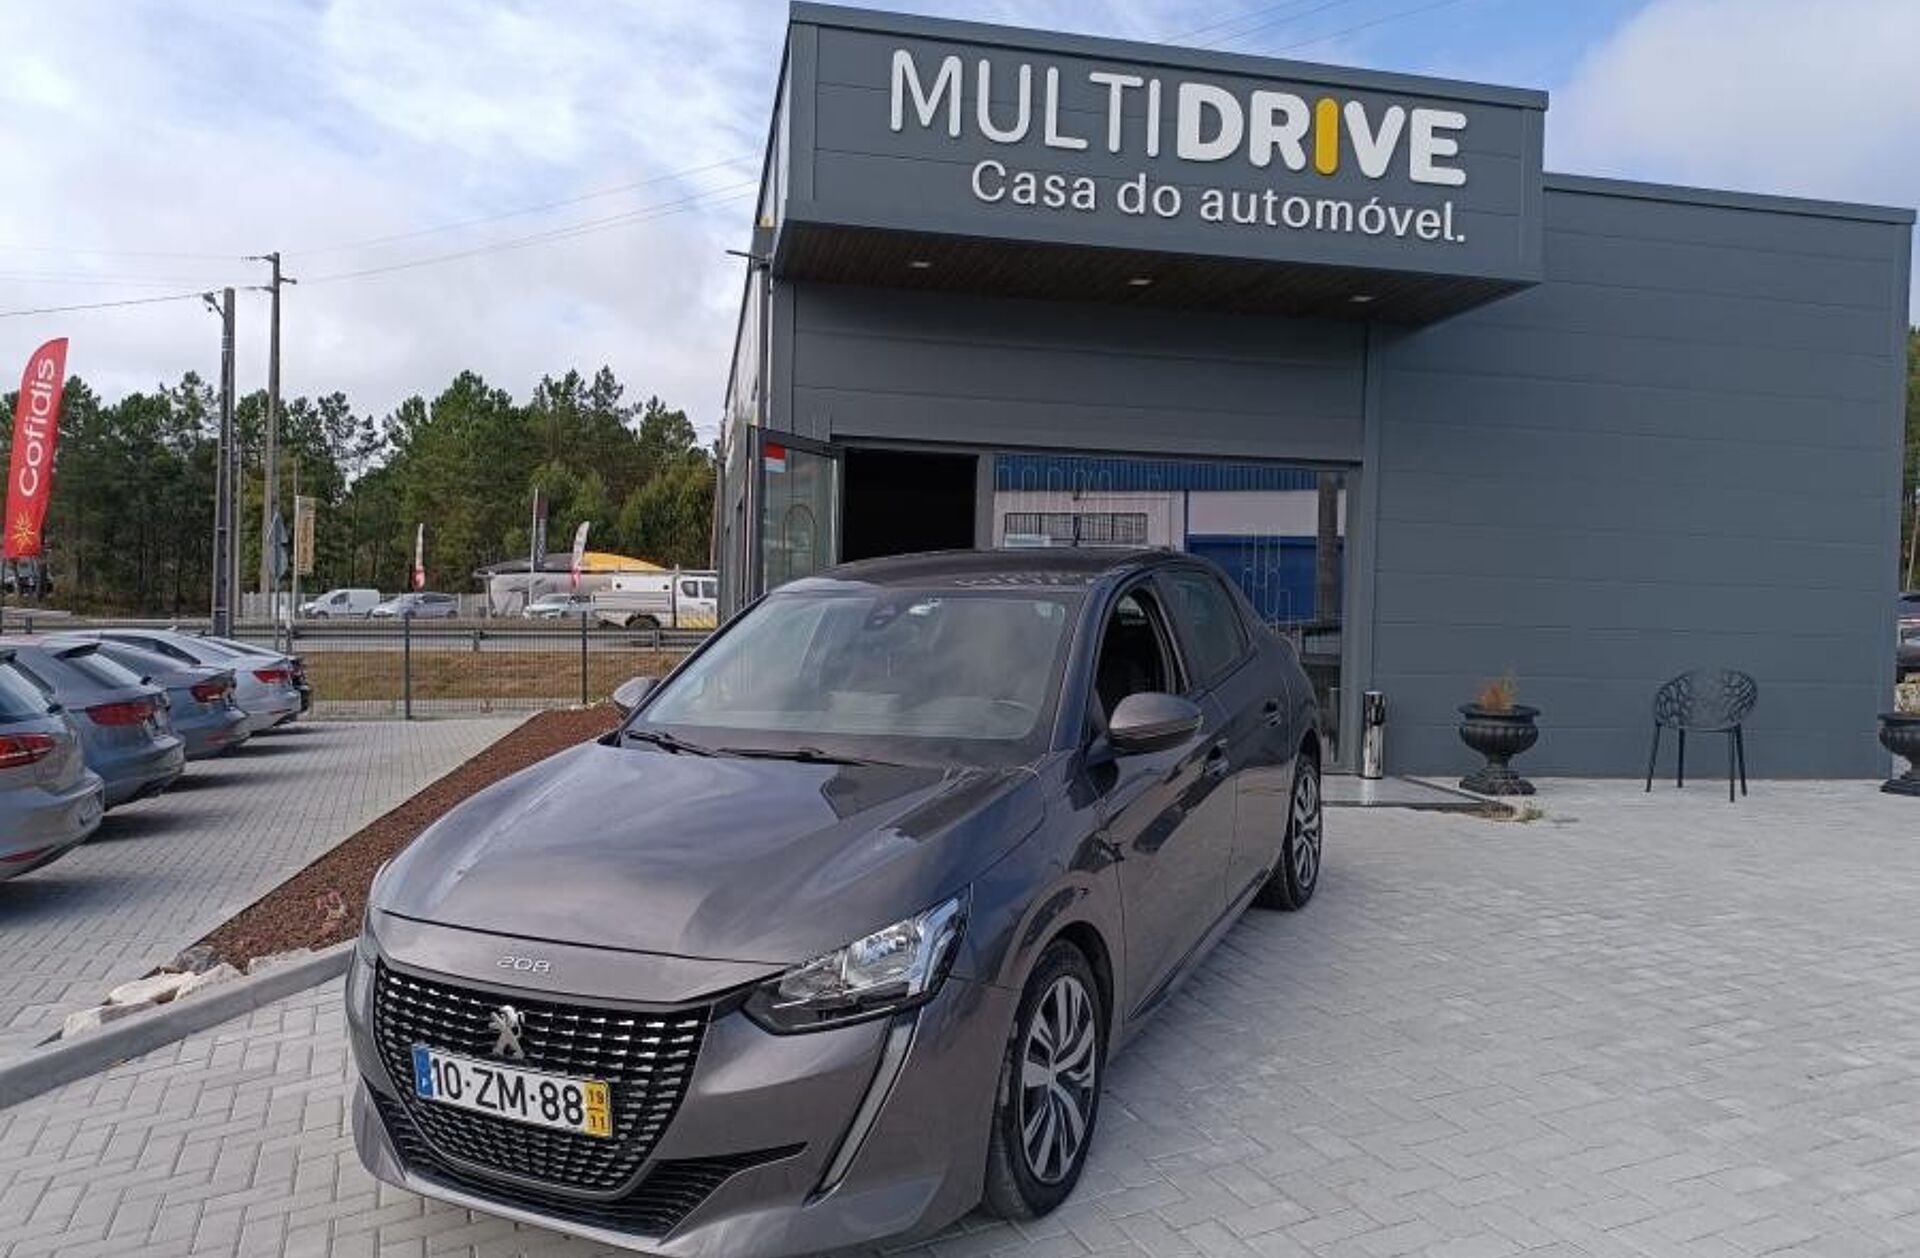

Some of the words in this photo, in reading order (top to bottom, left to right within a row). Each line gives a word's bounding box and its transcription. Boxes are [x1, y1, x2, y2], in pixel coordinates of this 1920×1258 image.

[971, 160, 1096, 210] Casa
[1117, 173, 1182, 217] do
[1200, 189, 1466, 243] automóvel.
[20, 359, 54, 496] Cofidis
